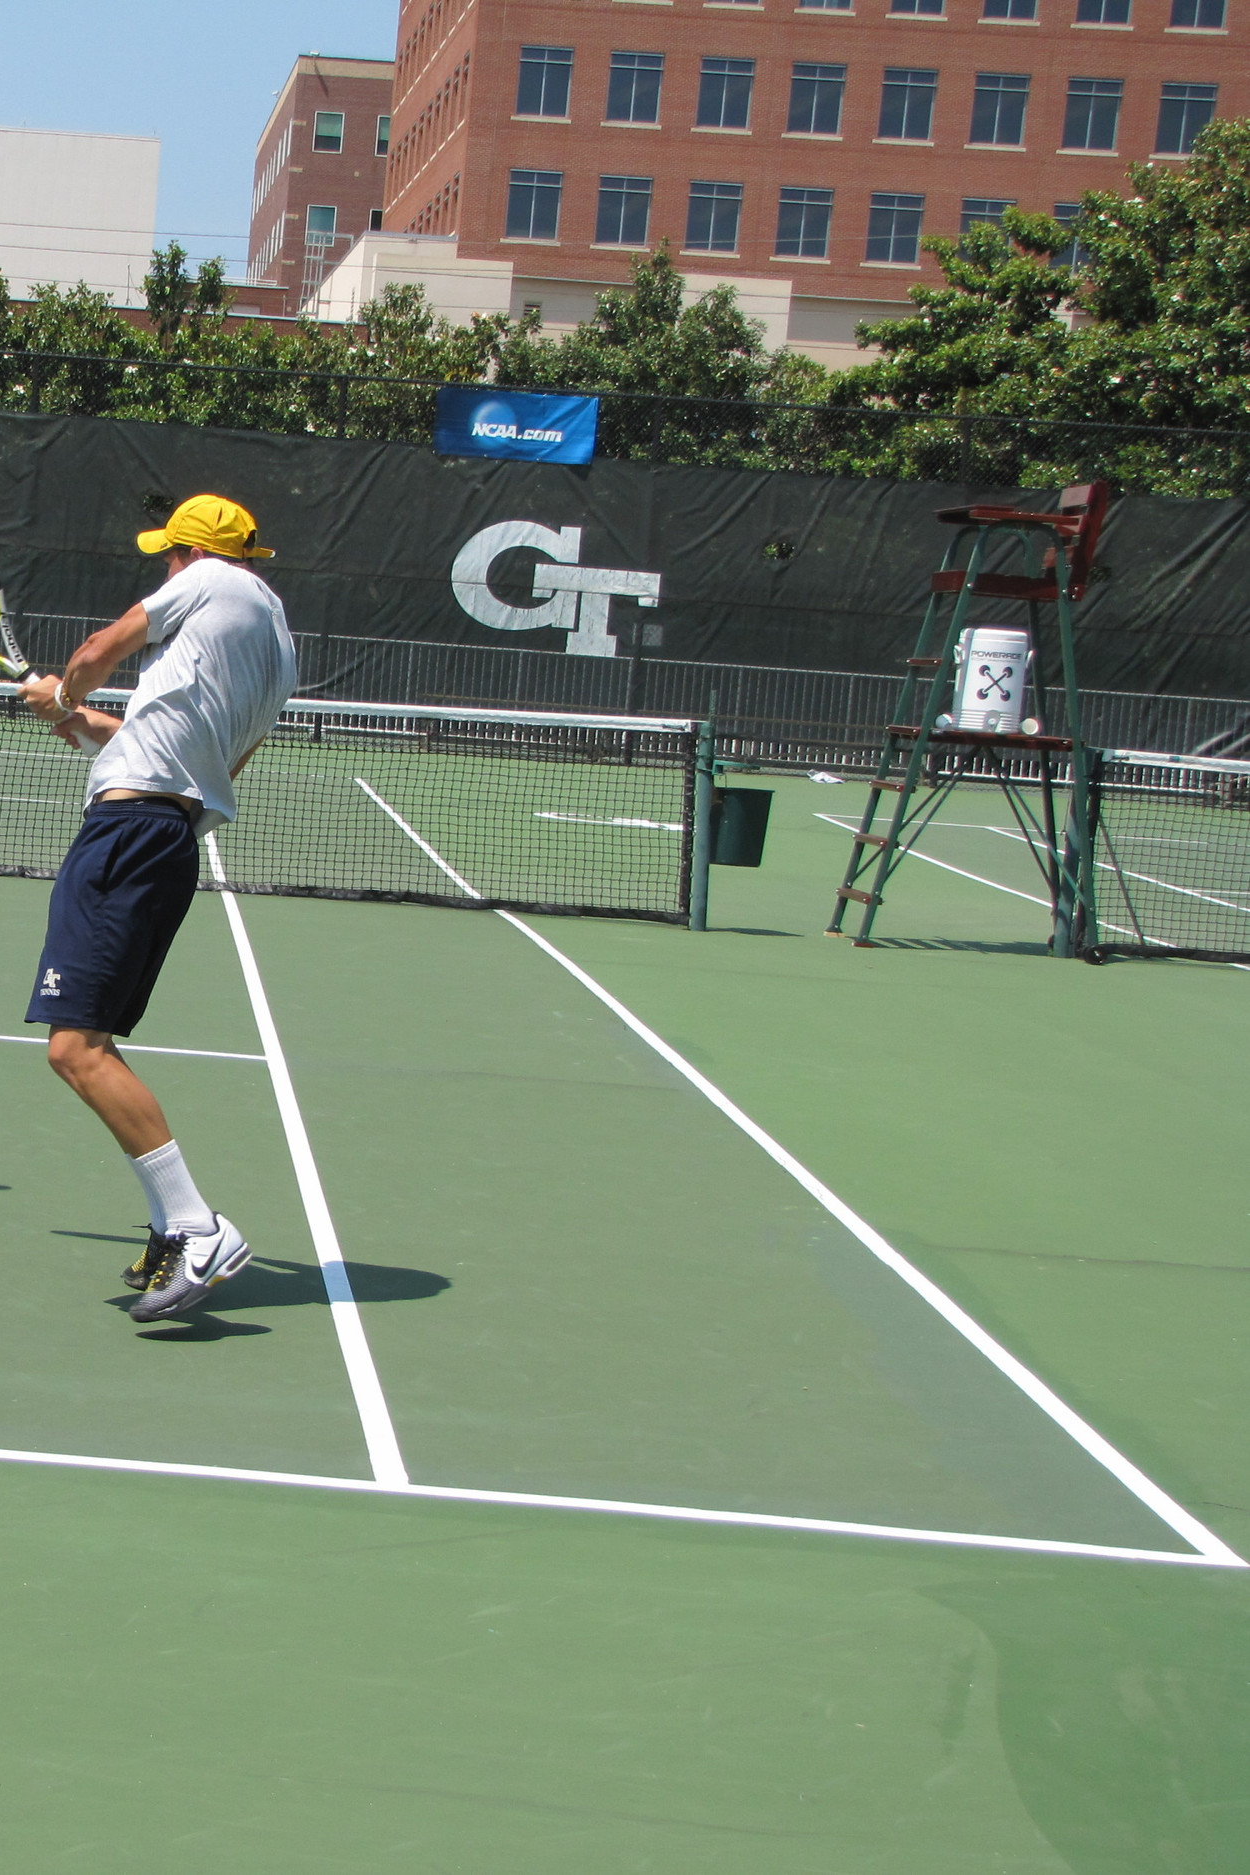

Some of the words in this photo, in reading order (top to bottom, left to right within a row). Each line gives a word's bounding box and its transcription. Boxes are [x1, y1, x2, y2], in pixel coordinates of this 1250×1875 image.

[471, 422, 563, 443] NCAA.com
[451, 520, 661, 657] GT
[971, 651, 1022, 659] POWERADE
